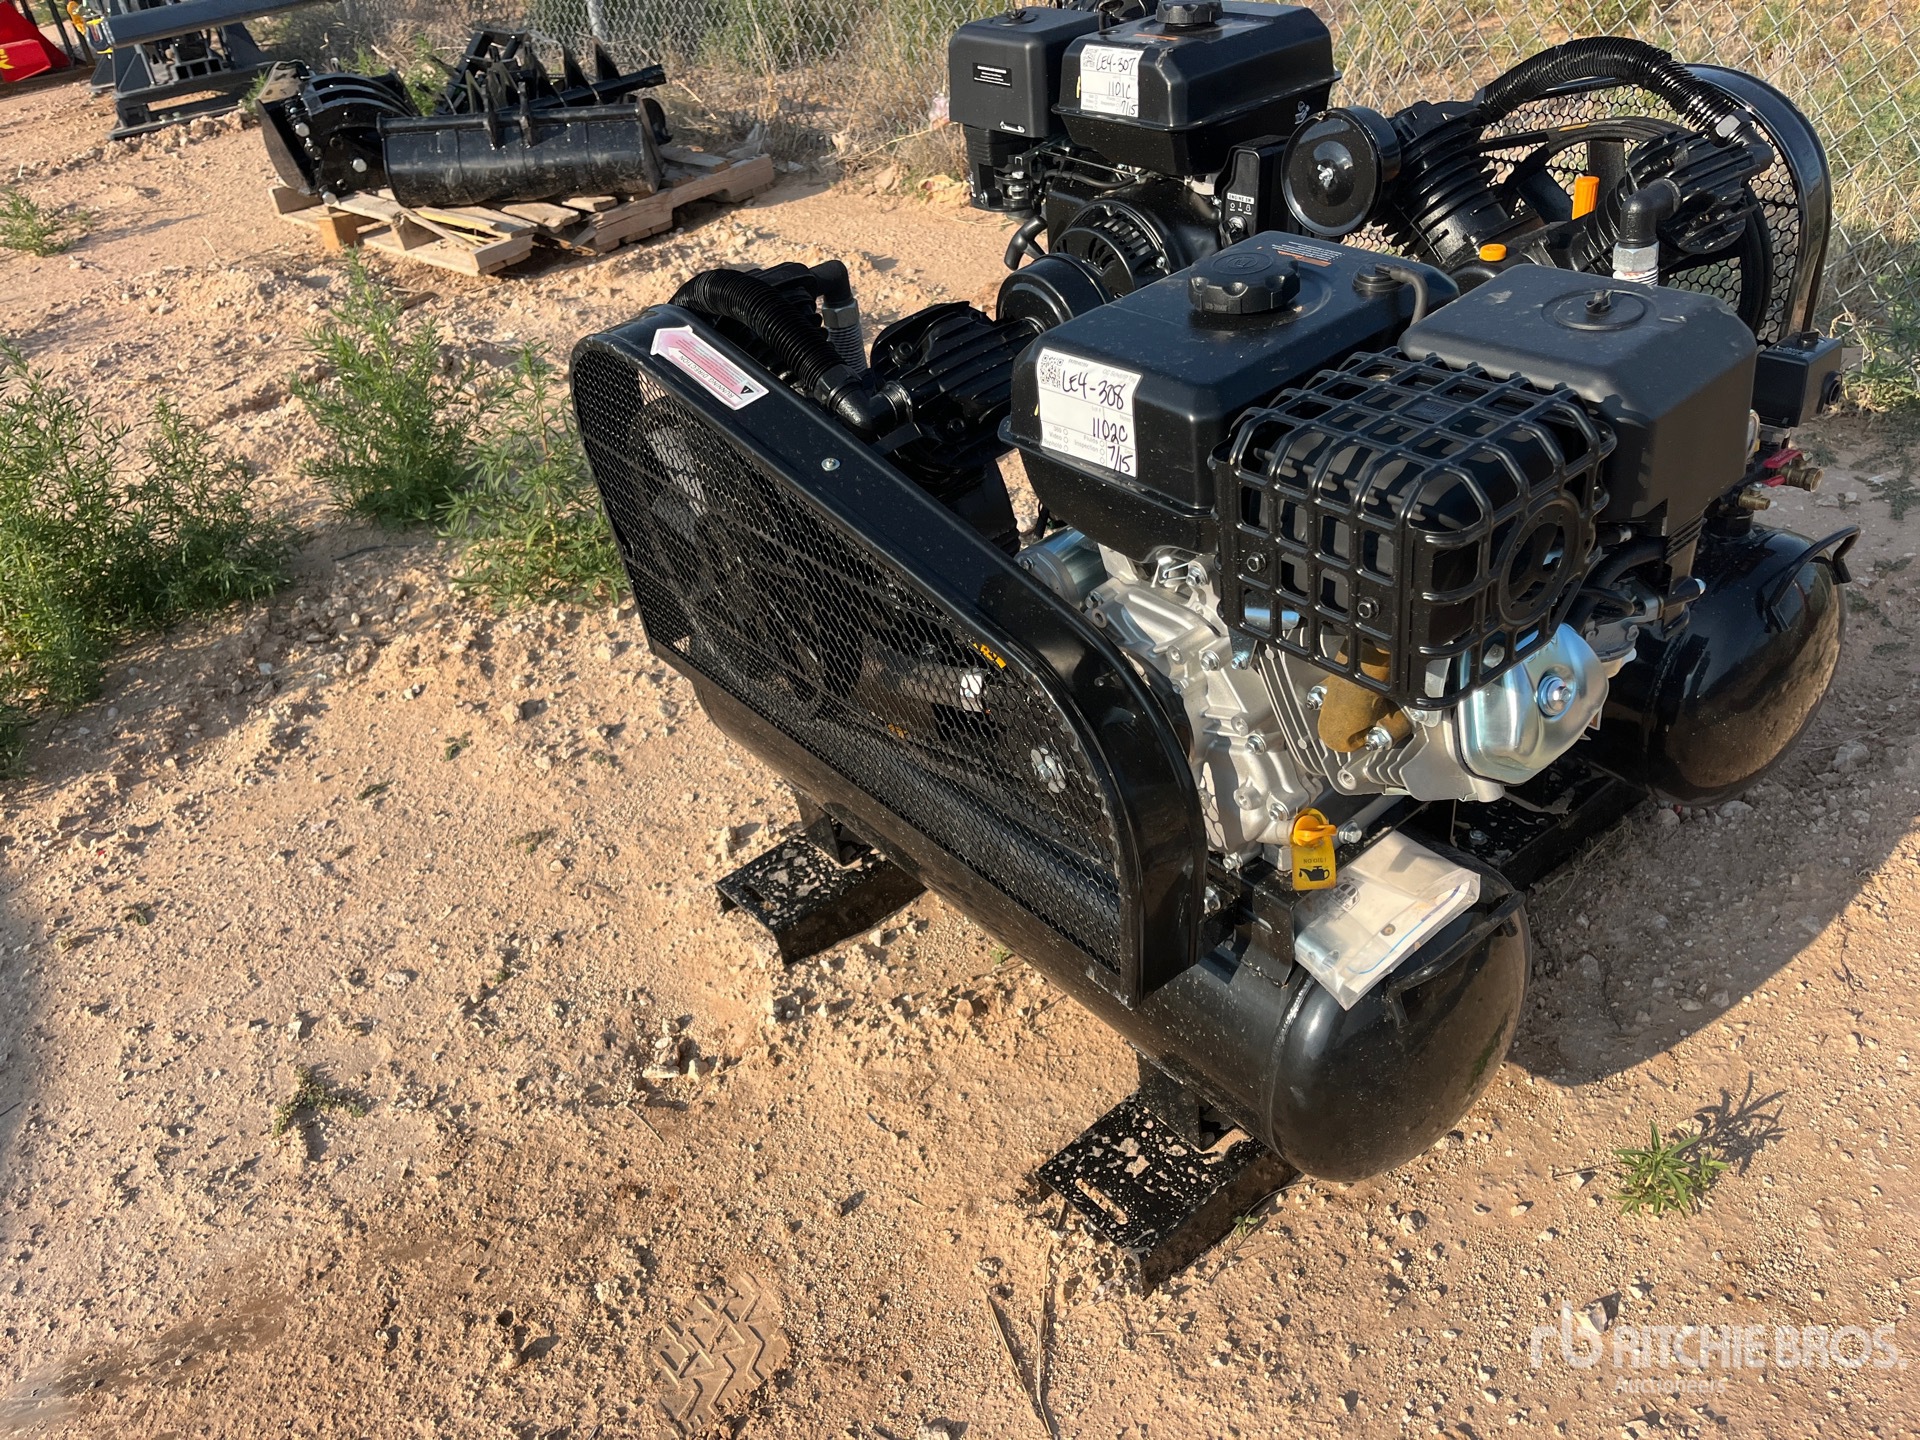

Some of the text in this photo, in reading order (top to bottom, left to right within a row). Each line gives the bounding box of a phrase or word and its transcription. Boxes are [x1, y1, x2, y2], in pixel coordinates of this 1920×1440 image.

[1096, 53, 1136, 76] LE4-307
[1121, 100, 1138, 116] 7/15
[680, 355, 709, 379] DIRECTION
[708, 378, 734, 398] RUNNING
[1062, 370, 1126, 410] LE4-308
[1108, 446, 1133, 473] 7/15
